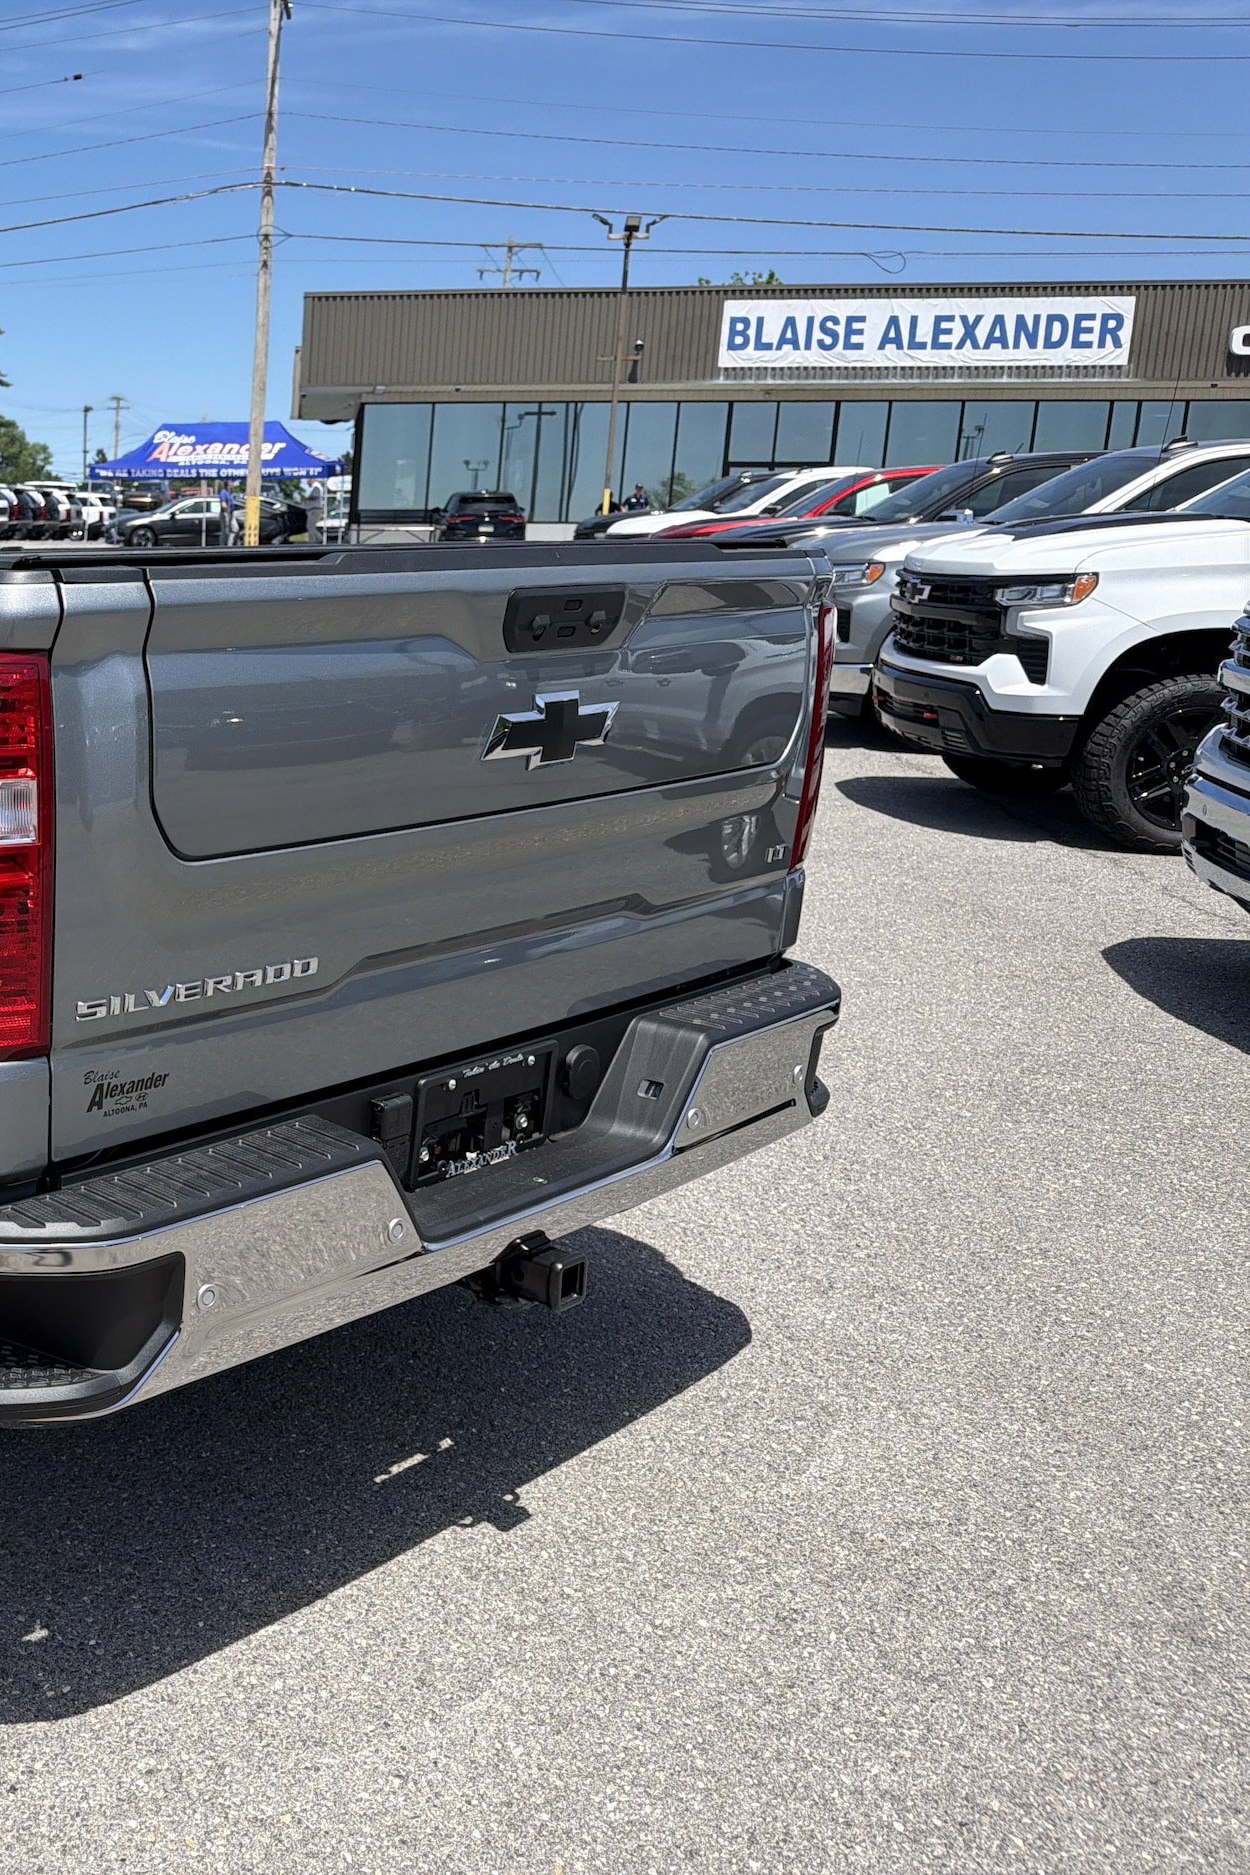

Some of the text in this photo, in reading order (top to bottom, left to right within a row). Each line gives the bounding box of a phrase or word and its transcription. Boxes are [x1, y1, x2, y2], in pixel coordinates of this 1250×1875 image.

[726, 312, 1125, 352] BLAISE ALEXANDER
[131, 469, 164, 477] TAKING
[166, 468, 197, 477] DEALS
[199, 468, 218, 477] THE
[219, 468, 248, 477] OTHE
[261, 467, 281, 476] UYS
[75, 956, 319, 1022] SILVERADO
[83, 1070, 120, 1085] Blaise
[86, 1072, 170, 1113] Alexander
[103, 1101, 148, 1118] ALTOONA, PA
[446, 1140, 519, 1178] ALEXANDER
